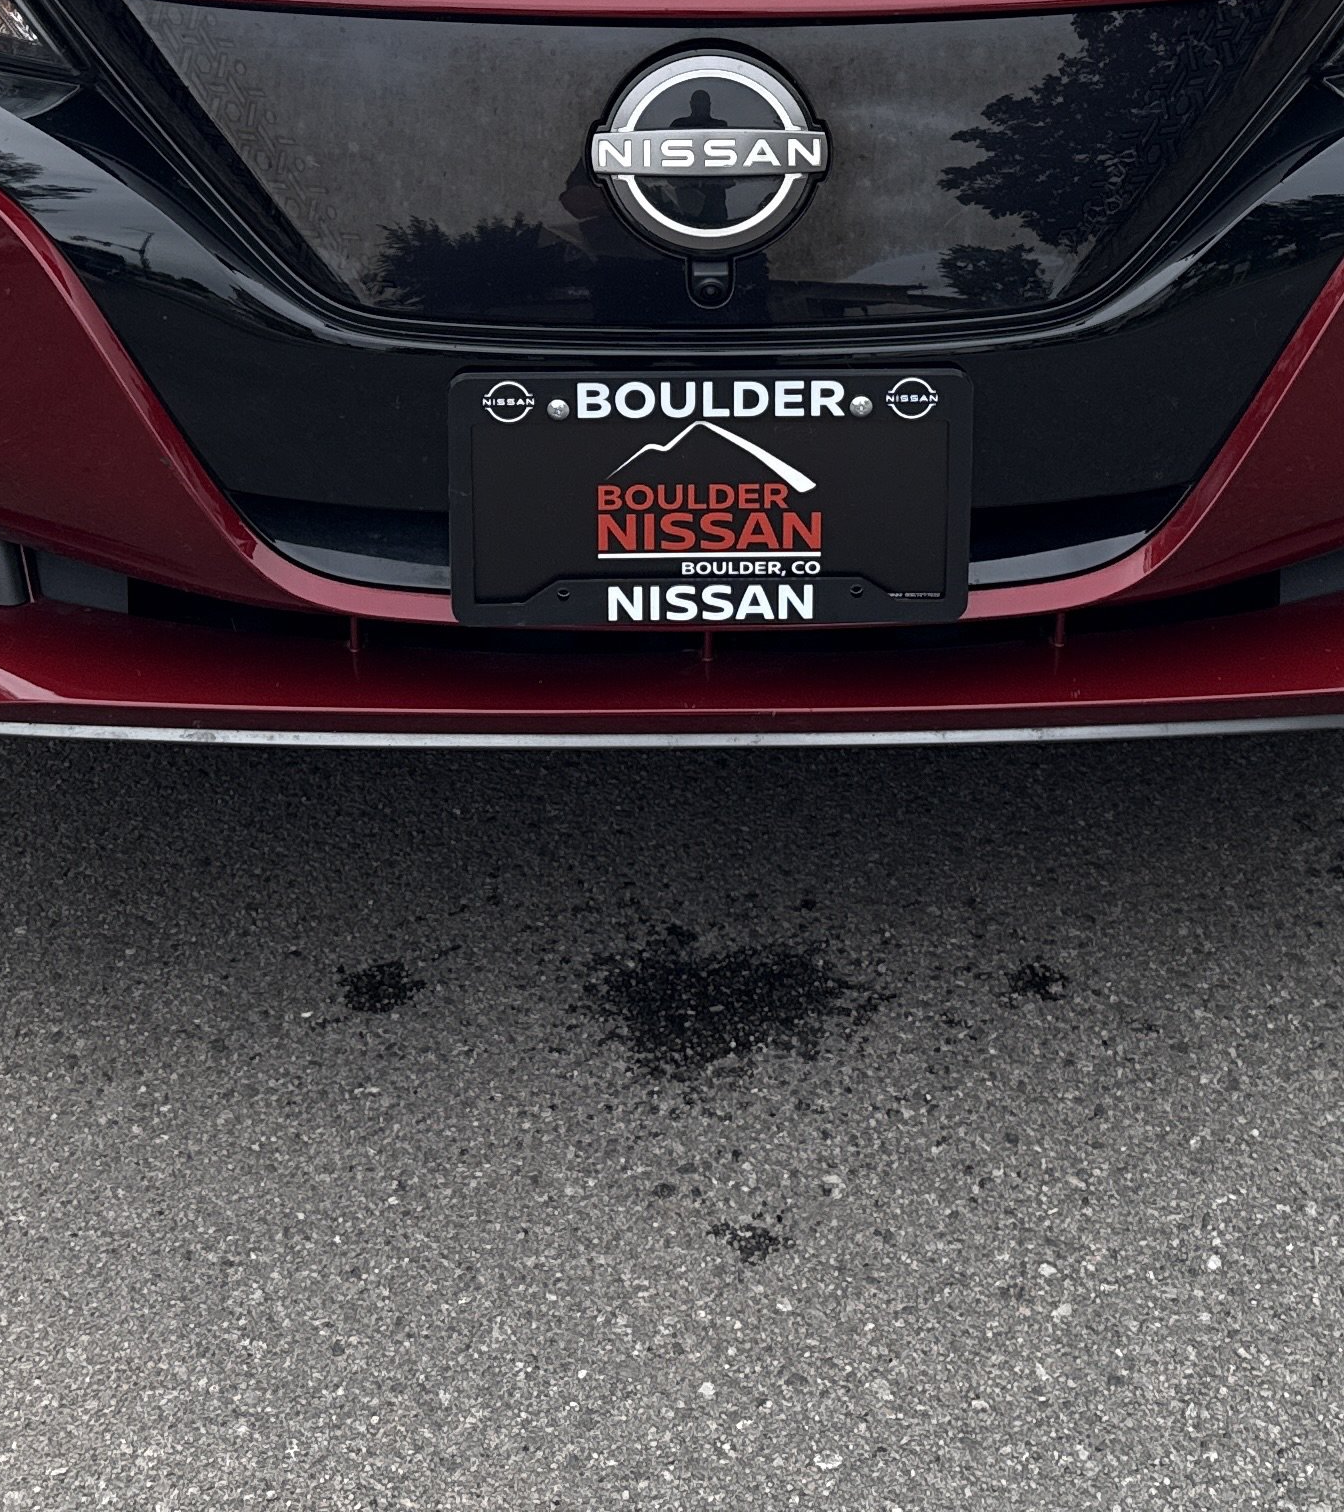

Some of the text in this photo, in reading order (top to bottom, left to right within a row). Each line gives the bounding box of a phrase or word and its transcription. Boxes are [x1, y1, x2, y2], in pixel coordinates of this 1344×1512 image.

[597, 138, 821, 168] NISSAN
[482, 397, 535, 407] NISSAN
[576, 380, 846, 419] BOULDER
[885, 393, 939, 403] NISSAN
[597, 483, 789, 511] BOULDER
[597, 511, 822, 551] NISSAN
[681, 560, 821, 576] BOULDER, CO
[607, 584, 814, 622] NISSAN
